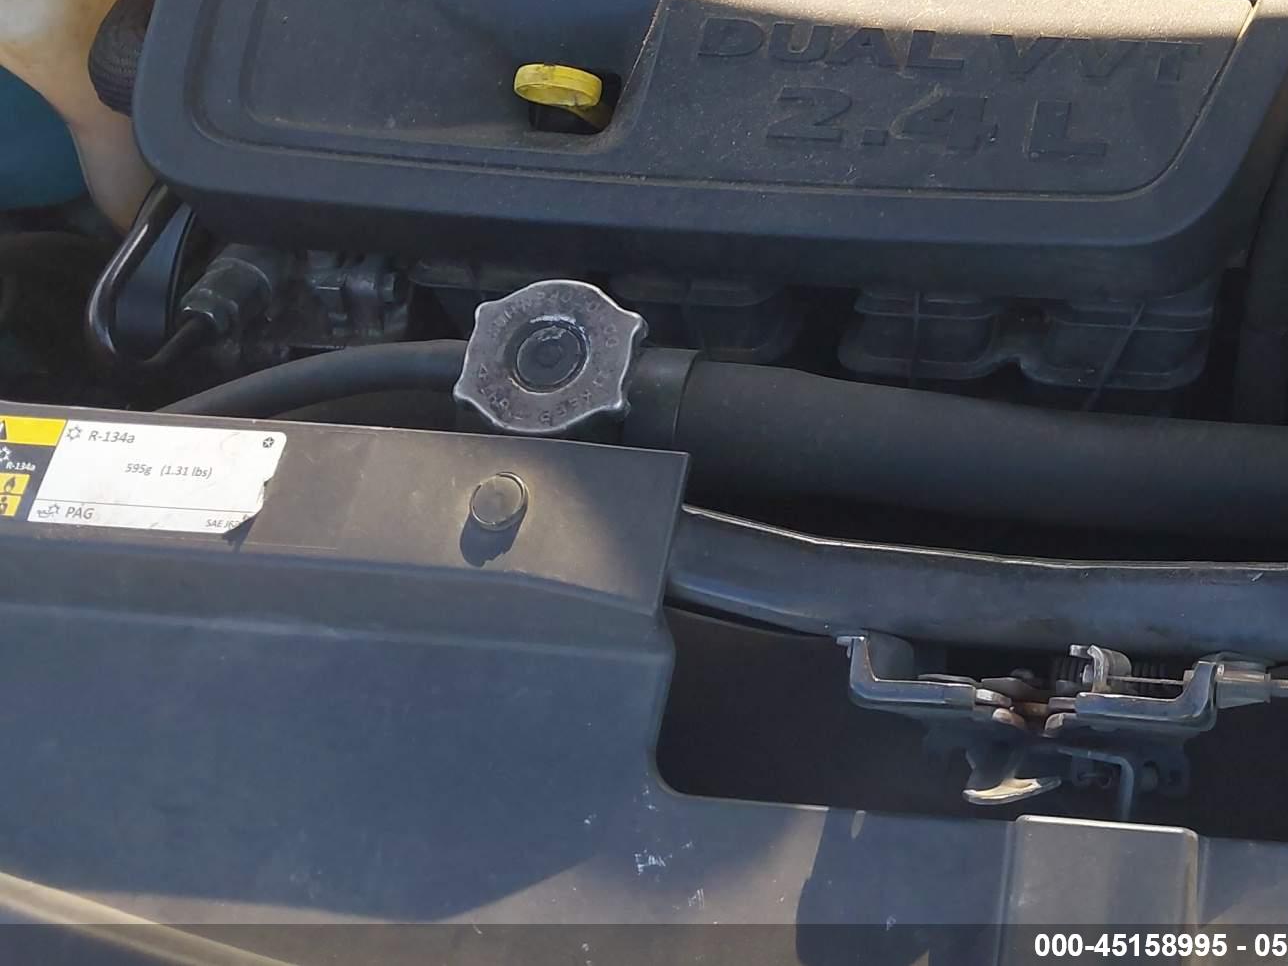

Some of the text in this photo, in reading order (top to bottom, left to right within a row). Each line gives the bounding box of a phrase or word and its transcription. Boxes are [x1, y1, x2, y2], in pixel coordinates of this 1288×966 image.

[698, 17, 1201, 81] DUAL VVT
[88, 430, 135, 444] R-134a
[5, 461, 36, 471] R-134a
[125, 463, 213, 479] 595g (1.31 lbs)
[65, 506, 95, 520] PAG
[205, 519, 223, 528] SAE
